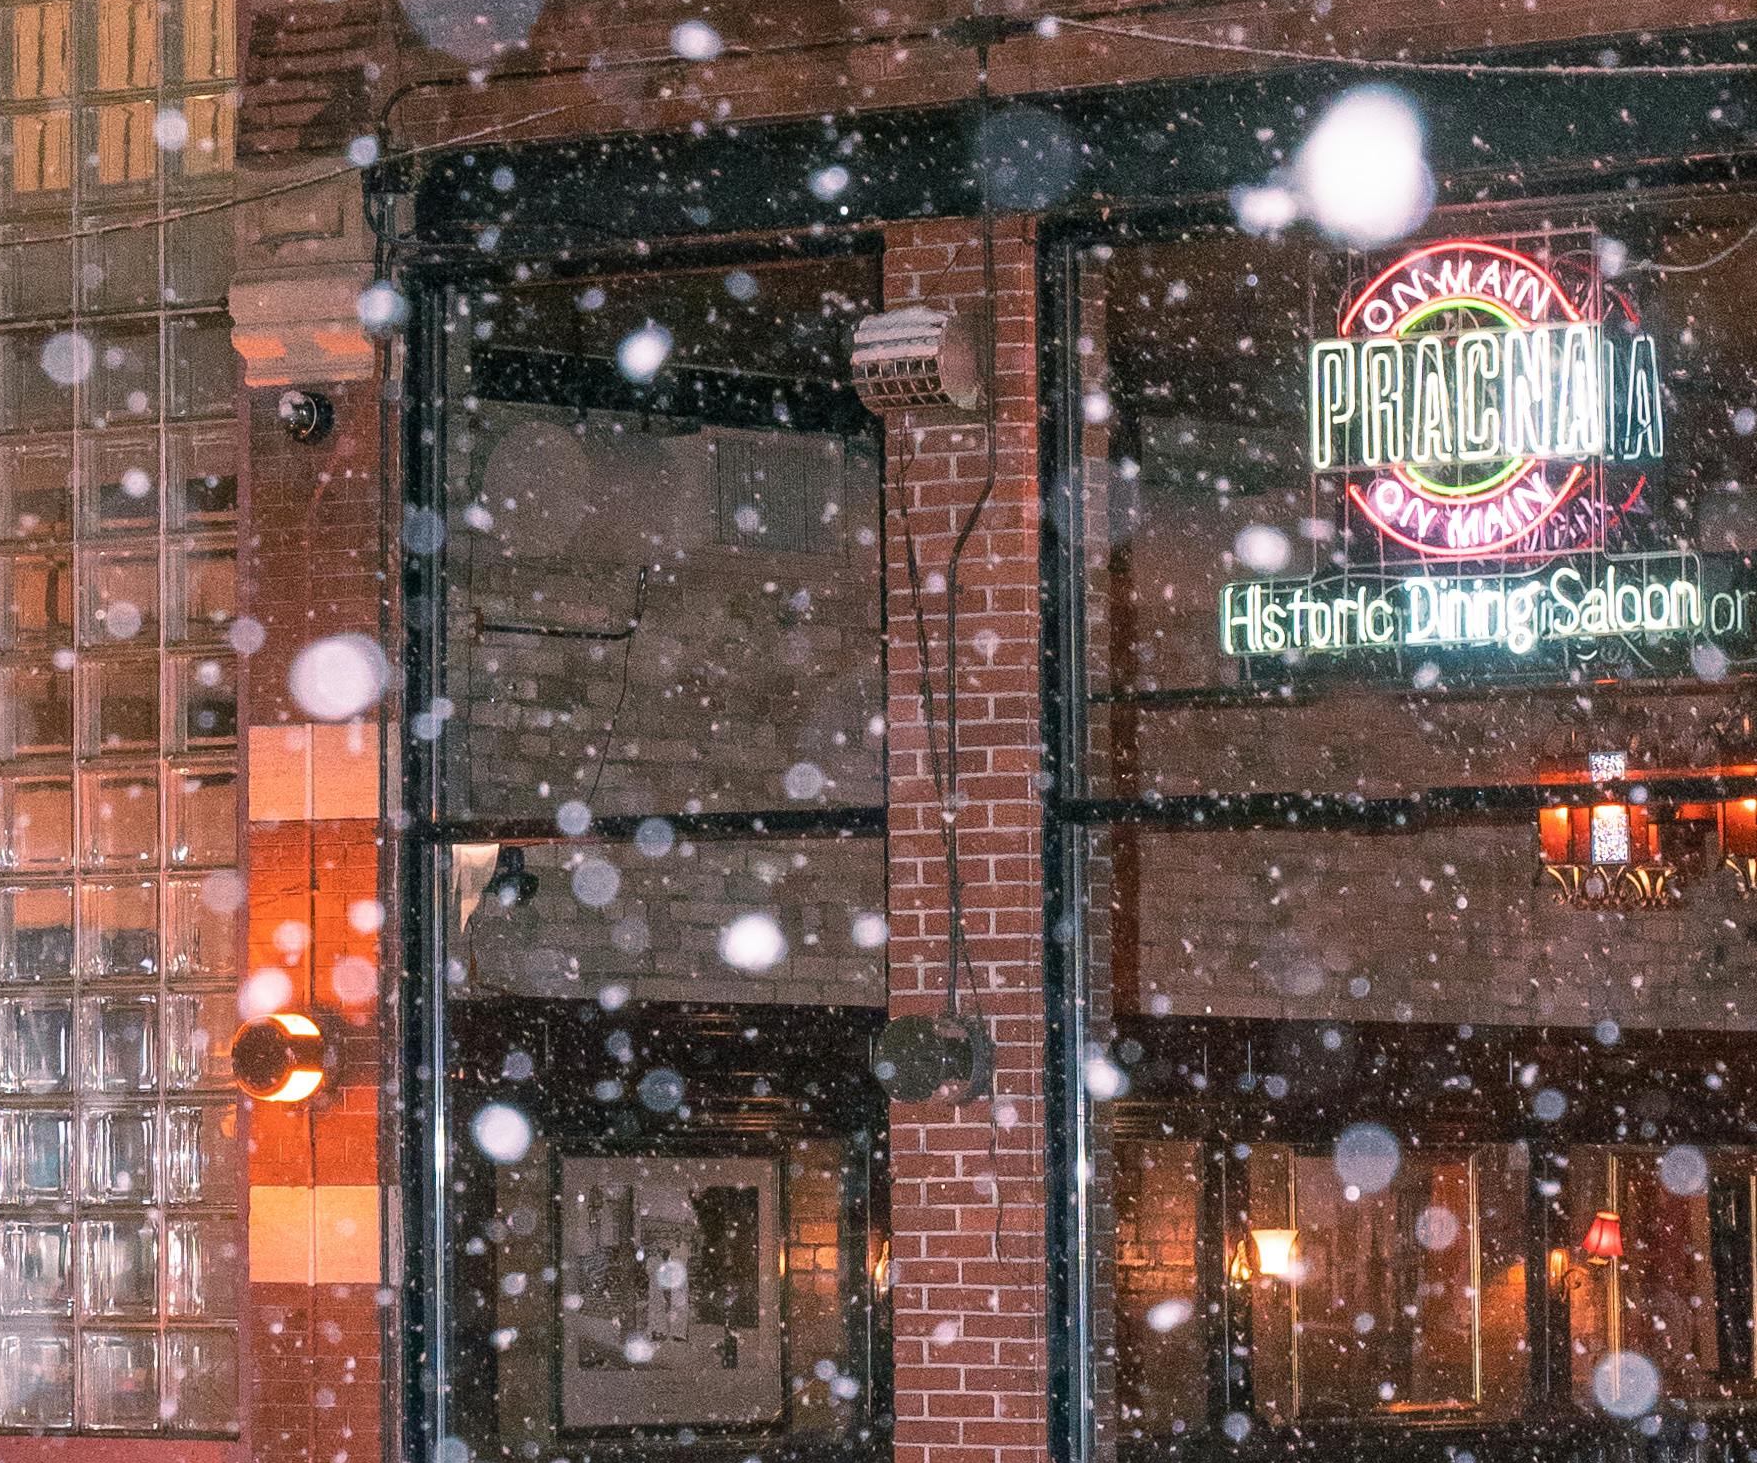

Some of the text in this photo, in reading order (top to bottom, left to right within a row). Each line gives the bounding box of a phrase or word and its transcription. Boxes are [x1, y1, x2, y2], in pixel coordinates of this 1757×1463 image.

[1364, 260, 1552, 333] ON MAIN
[1312, 324, 1602, 469] PRACNA
[1375, 480, 1437, 538] ON
[1224, 583, 1395, 655] Historic
[1405, 579, 1540, 654] Dining
[1551, 566, 1702, 635] Saloon
